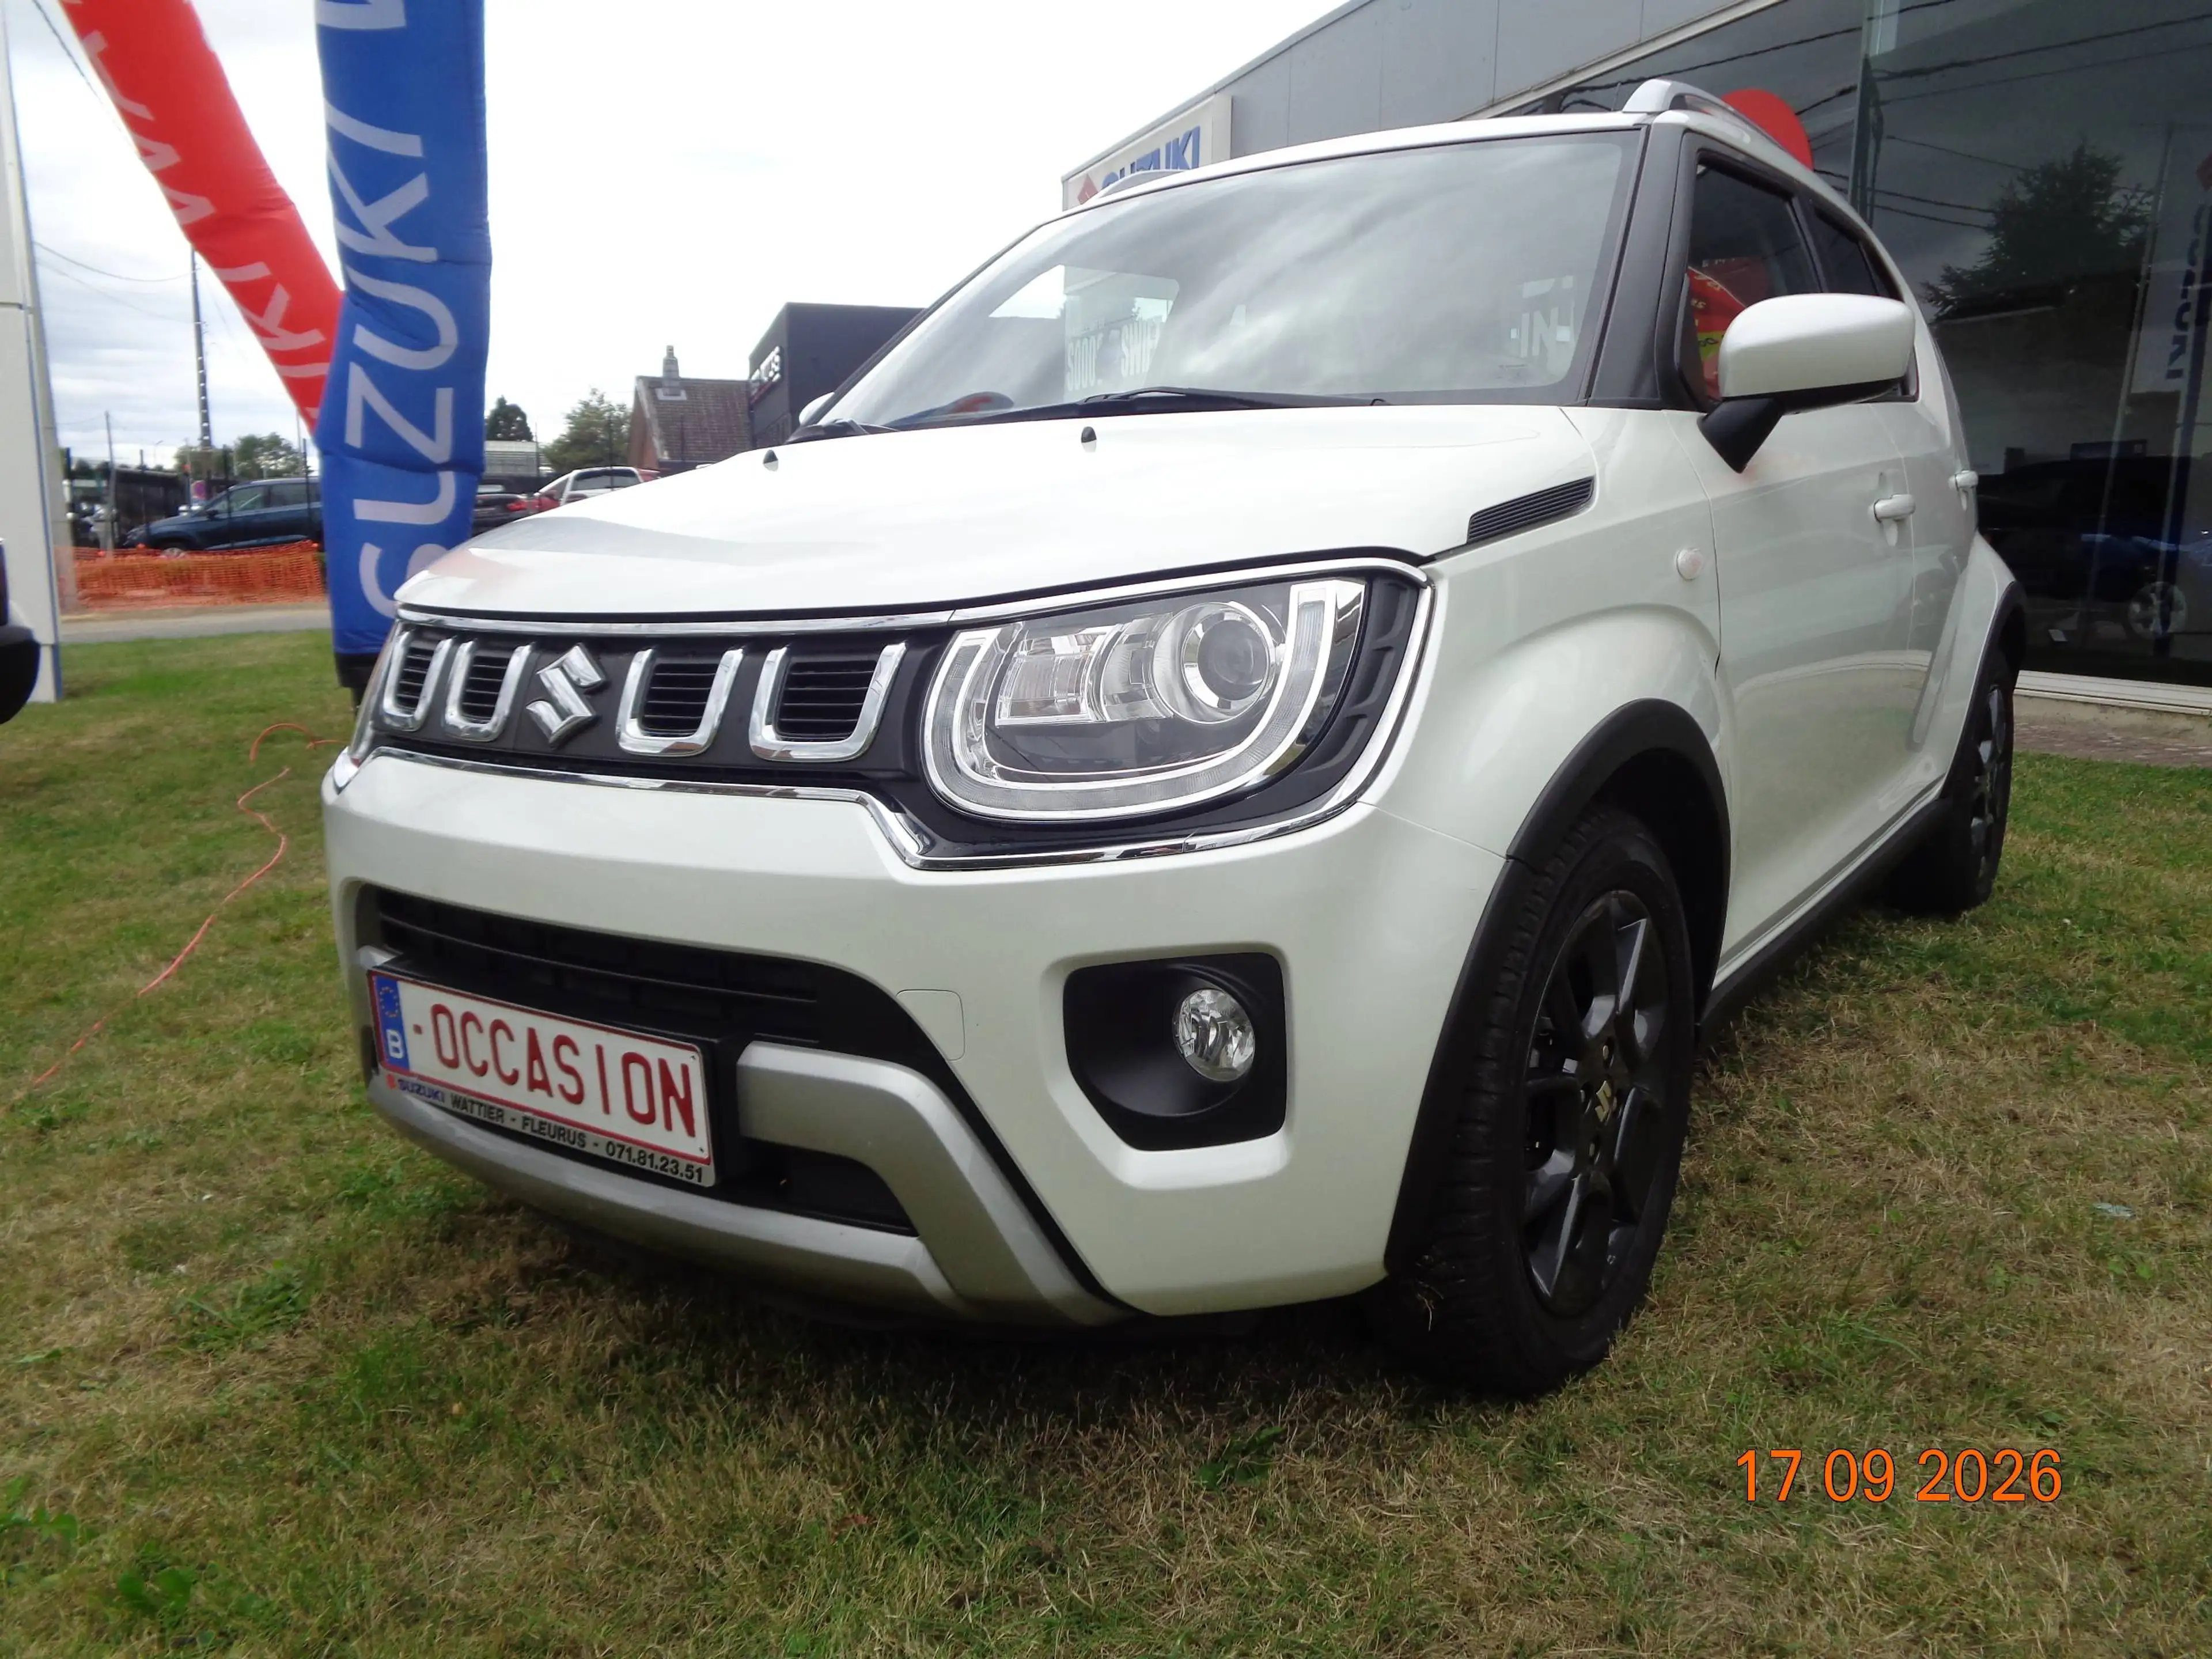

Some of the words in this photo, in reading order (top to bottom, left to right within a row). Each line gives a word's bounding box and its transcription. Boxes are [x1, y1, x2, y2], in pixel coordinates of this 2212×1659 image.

[385, 1029, 404, 1059] B
[397, 1078, 445, 1103] SUZUKI
[450, 1093, 505, 1123] WATTIER
[521, 1116, 586, 1147] FLEURUS
[605, 1141, 703, 1183] 071.81.23.51
